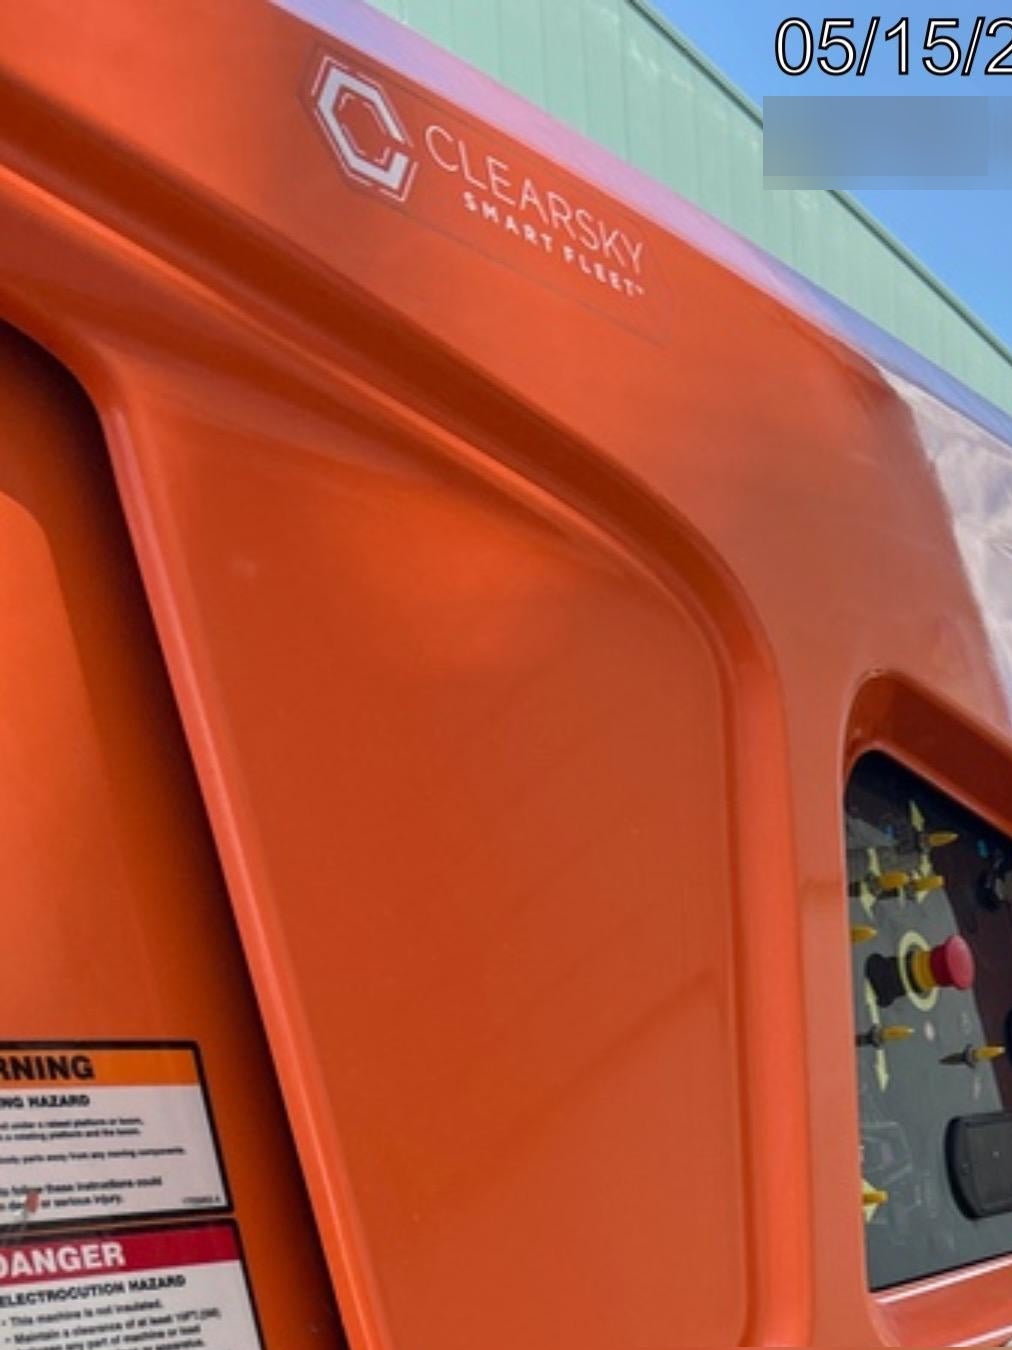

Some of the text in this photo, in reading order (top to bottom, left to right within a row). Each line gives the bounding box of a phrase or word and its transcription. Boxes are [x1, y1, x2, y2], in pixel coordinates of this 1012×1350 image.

[424, 124, 643, 273] CLEARSKY
[463, 190, 553, 252] SMART
[29, 1093, 91, 1107] HAZARD
[0, 1274, 187, 1307] ELECTROCUTION HAZARD
